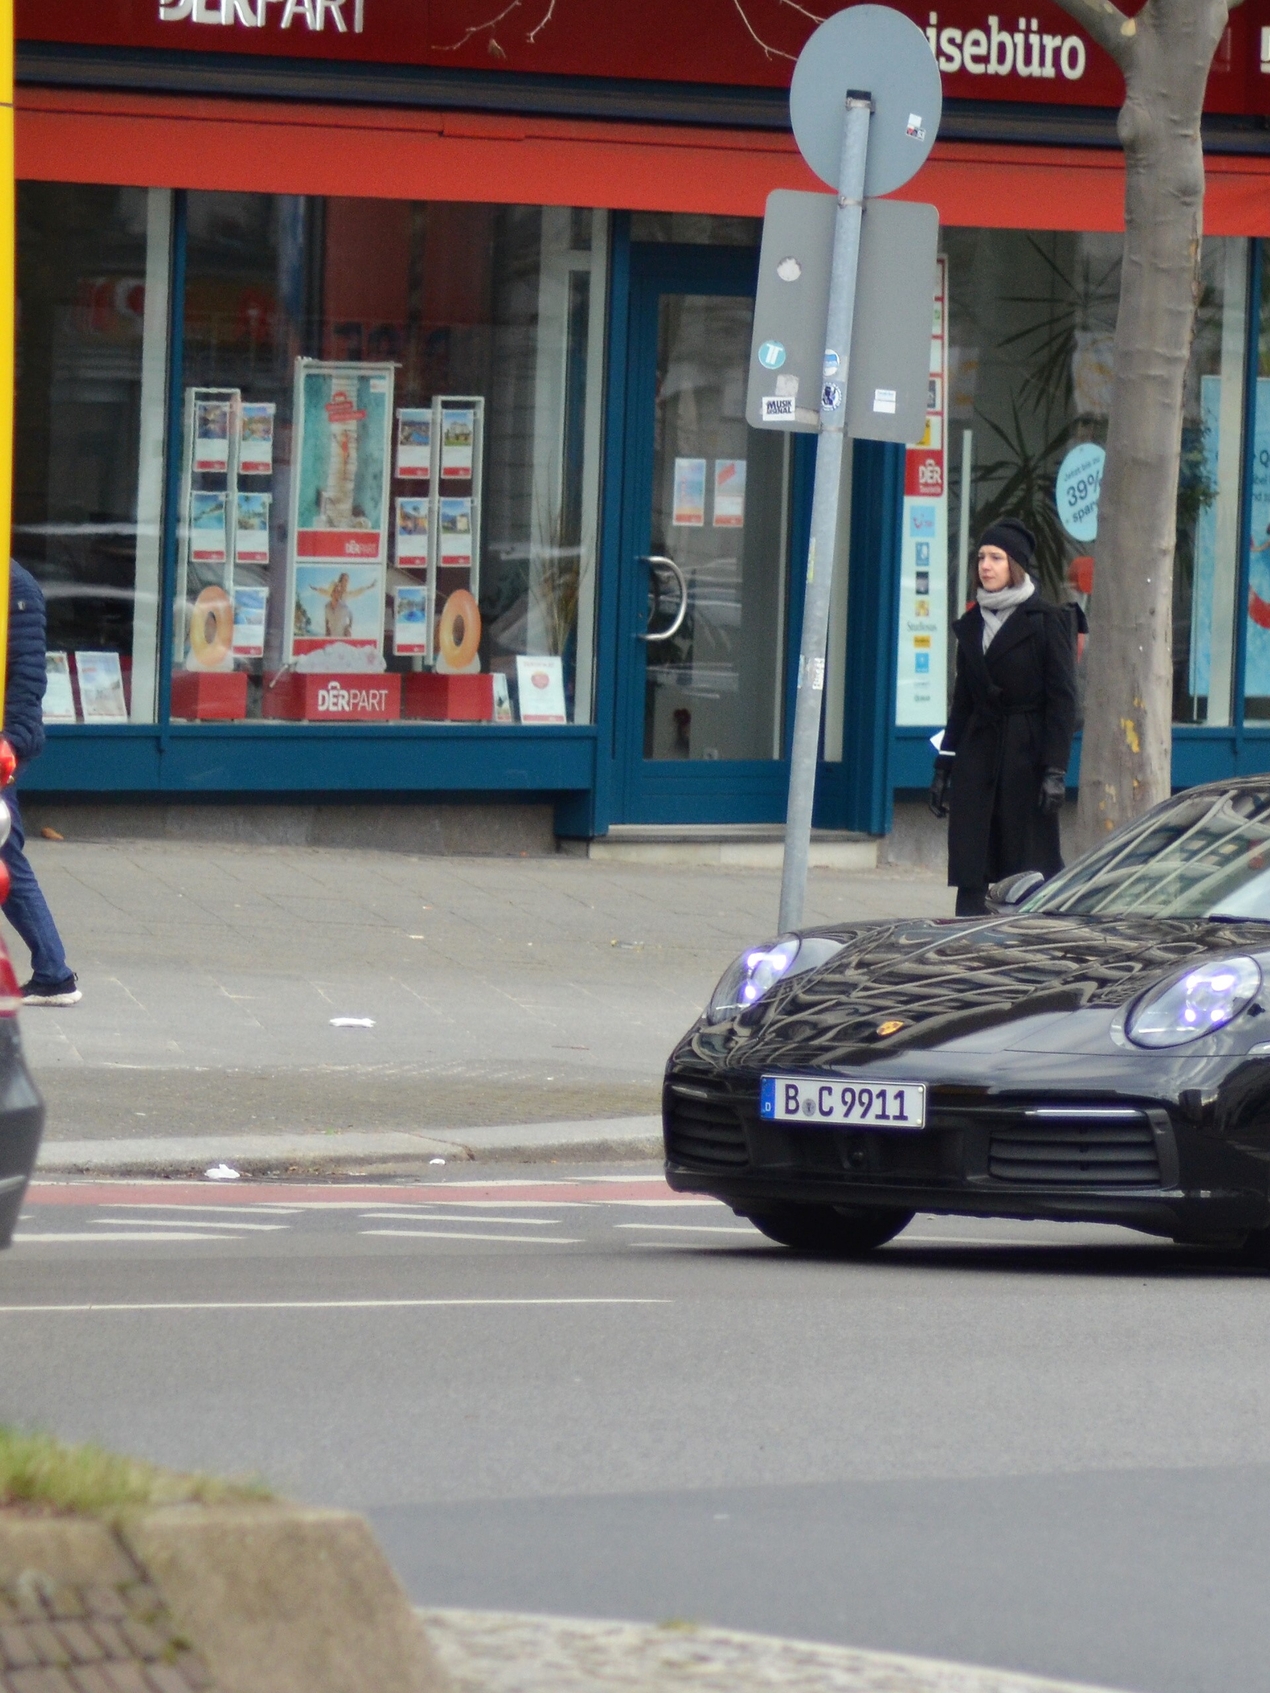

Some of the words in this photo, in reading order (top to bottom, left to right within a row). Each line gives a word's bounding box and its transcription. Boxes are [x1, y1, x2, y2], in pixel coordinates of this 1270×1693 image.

[1066, 470, 1100, 507] 39%
[318, 685, 388, 712] DERPART
[784, 1083, 800, 1115] B
